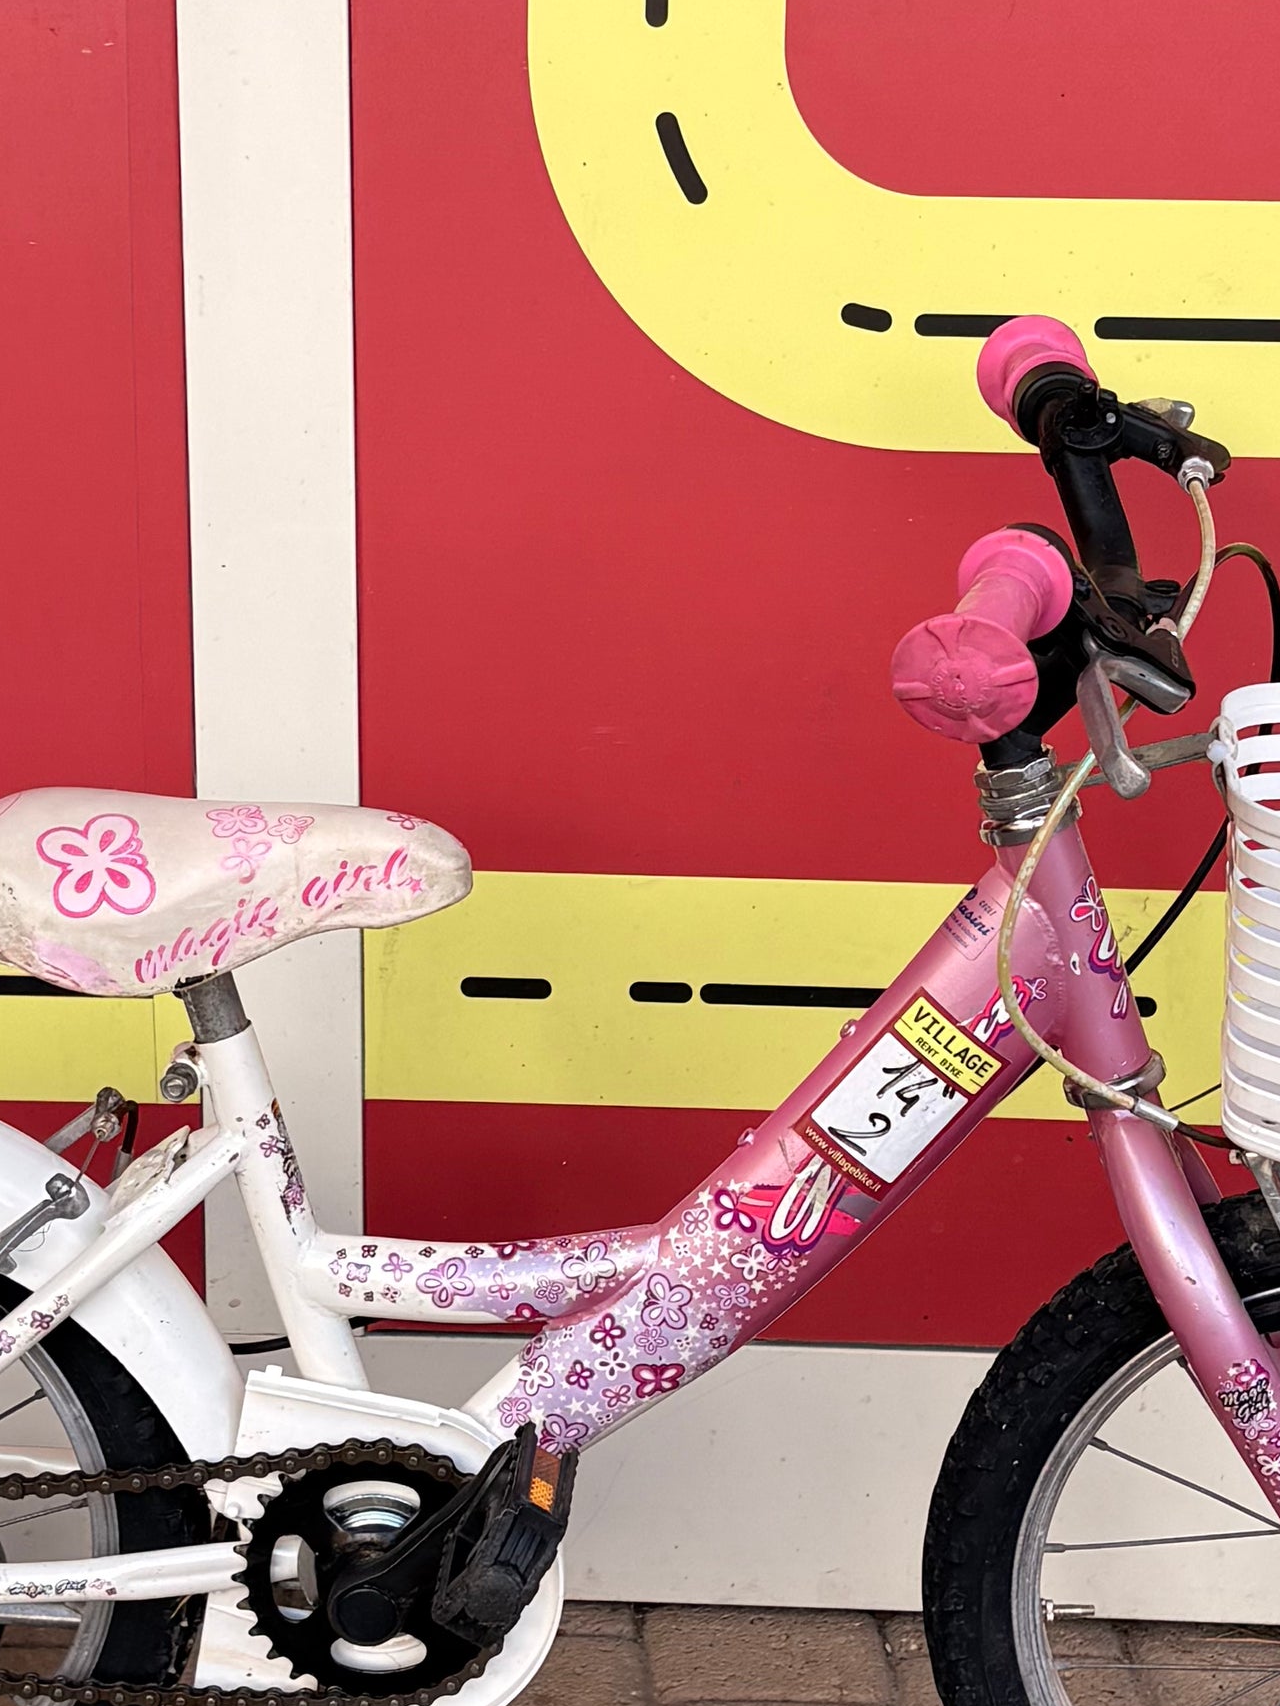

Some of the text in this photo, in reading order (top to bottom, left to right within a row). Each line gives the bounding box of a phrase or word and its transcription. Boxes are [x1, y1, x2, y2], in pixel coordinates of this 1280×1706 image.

[911, 1005, 994, 1079] VILLAGE
[915, 1036, 964, 1080] RENT BIKE
[827, 1112, 891, 1157] 2
[804, 1125, 883, 1193] www.villagebike.it
[1218, 1377, 1270, 1408] Magic
[1236, 1392, 1270, 1424] Girl
